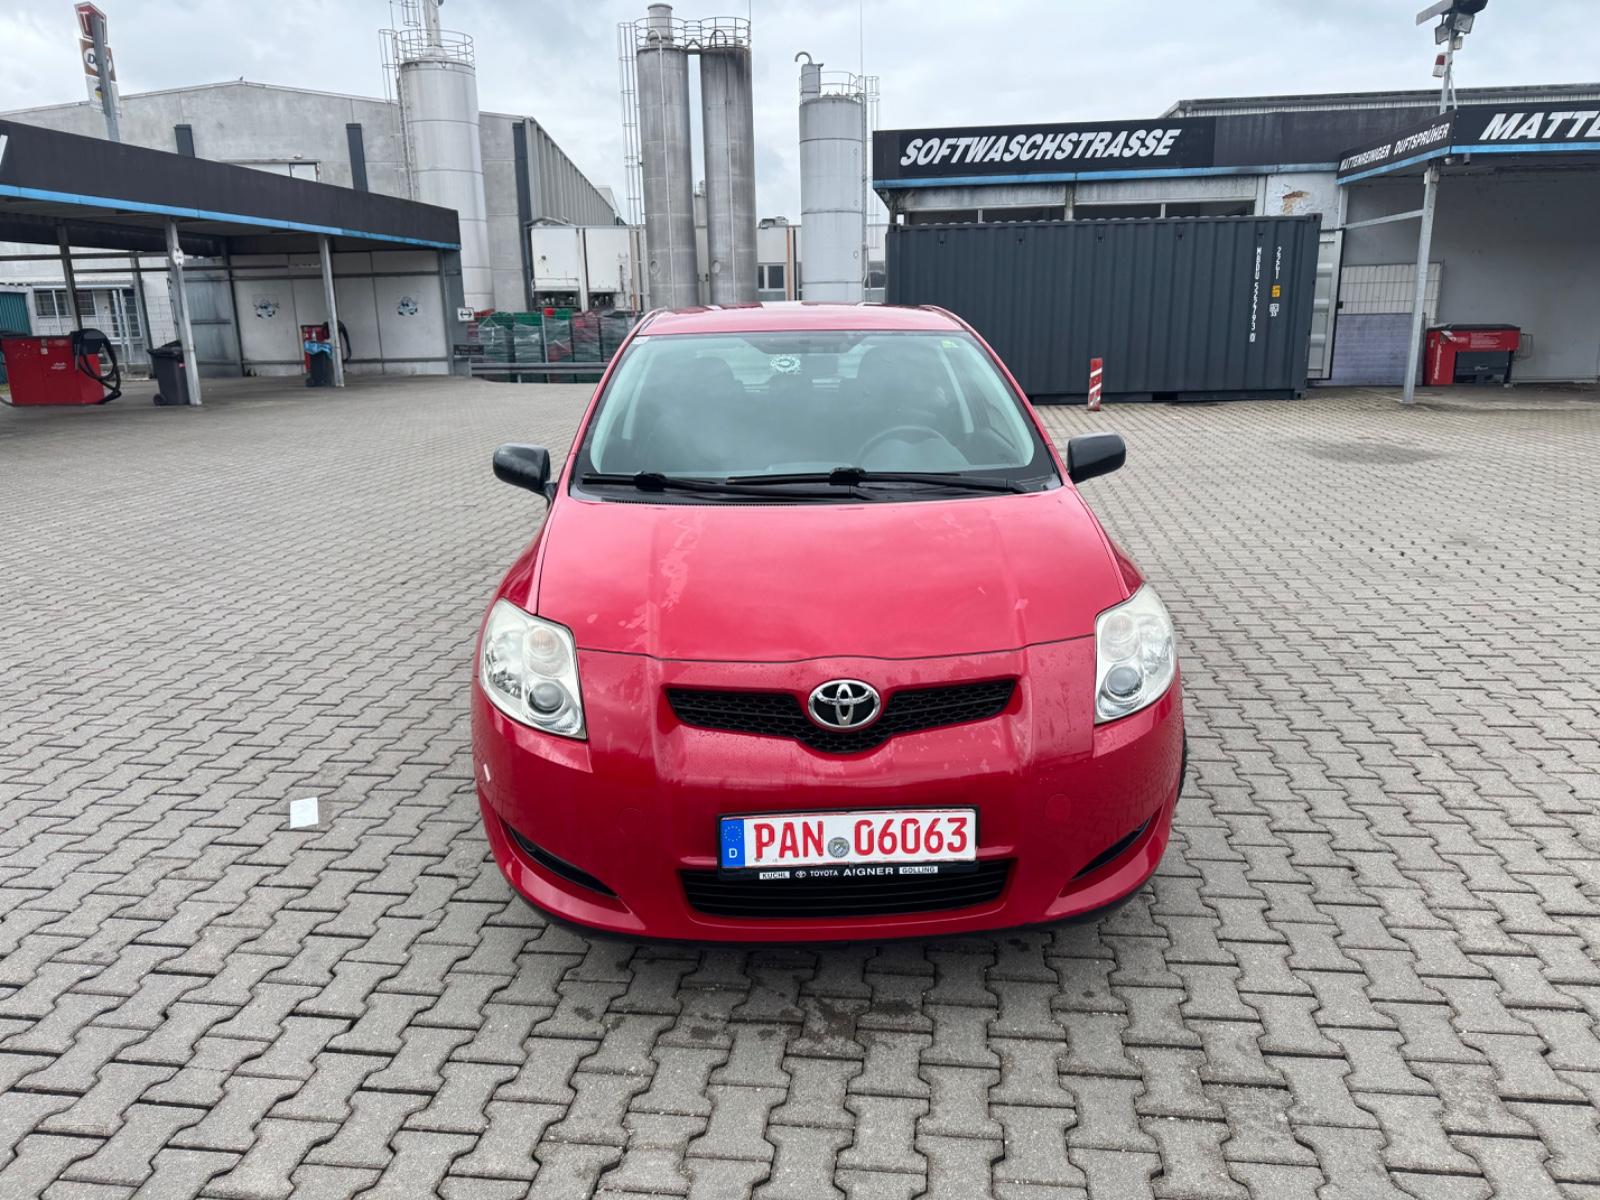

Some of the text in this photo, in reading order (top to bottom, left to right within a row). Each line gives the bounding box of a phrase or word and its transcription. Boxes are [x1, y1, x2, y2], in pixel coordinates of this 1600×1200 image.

[900, 128, 1183, 167] SOFTWASCHSTRASSE
[728, 848, 738, 859] D
[753, 819, 824, 860] PAN
[854, 817, 968, 856] 06063
[810, 869, 839, 877] TOYOTA
[843, 867, 894, 877] AIGNER
